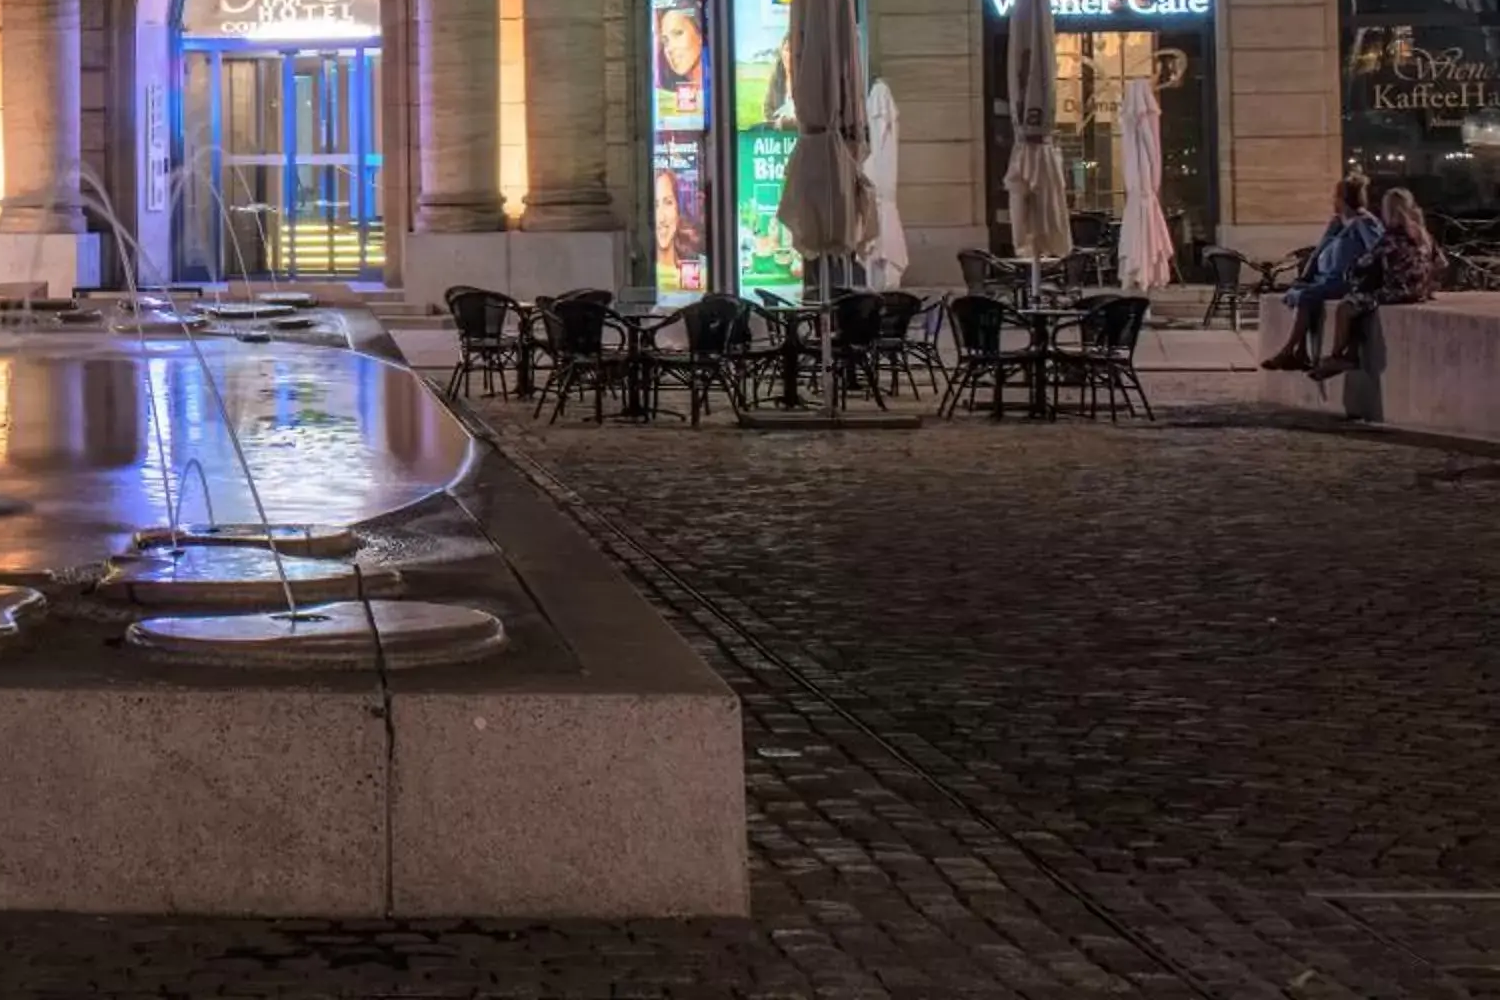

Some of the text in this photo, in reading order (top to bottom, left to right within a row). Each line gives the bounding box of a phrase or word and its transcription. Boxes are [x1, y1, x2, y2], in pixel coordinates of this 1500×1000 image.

[257, 3, 355, 25] HOTEL
[1373, 82, 1500, 110] KaffeeHa
[753, 137, 781, 154] Alle
[753, 156, 789, 181] Bio
